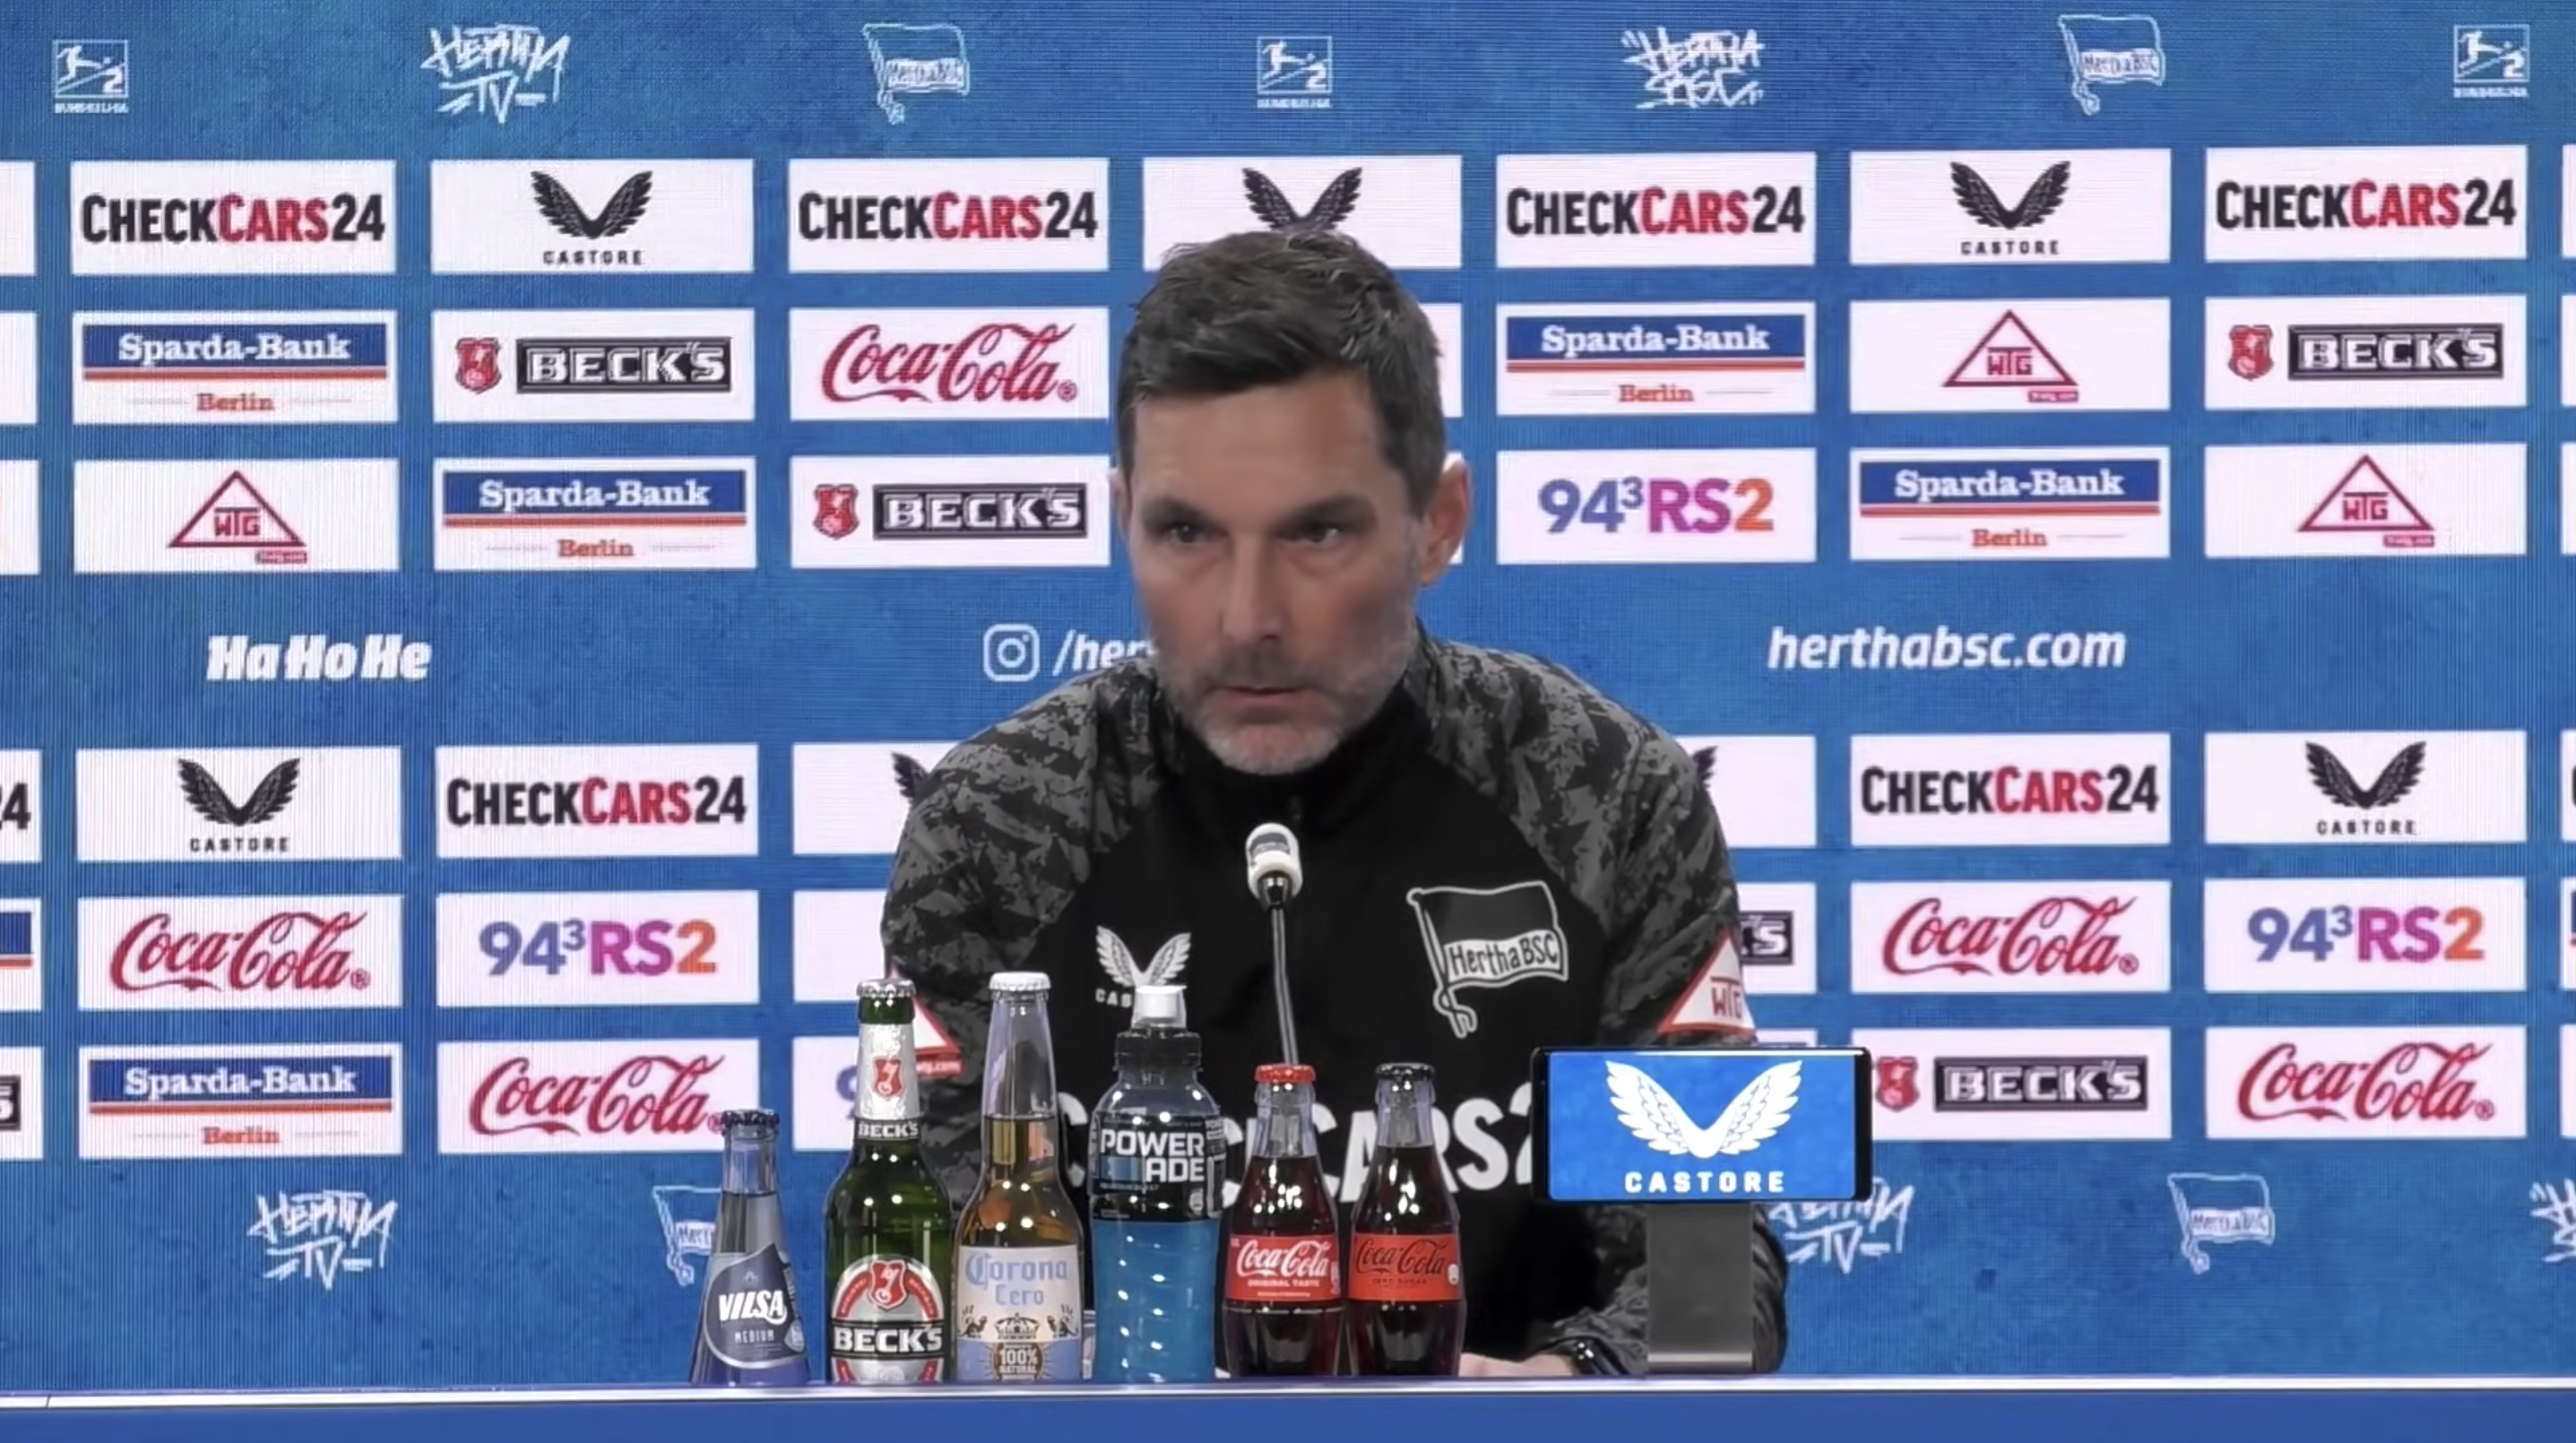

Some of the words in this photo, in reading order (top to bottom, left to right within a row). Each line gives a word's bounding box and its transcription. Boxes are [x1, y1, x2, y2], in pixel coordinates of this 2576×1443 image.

[543, 250, 642, 265] CASTORE
[1961, 240, 2059, 255] CASTORE
[119, 333, 351, 362] Sparda-Bank
[1541, 324, 1769, 358] Sparda-Bank
[2298, 328, 2496, 369] BECK'S
[526, 341, 725, 384] BECK'S
[1987, 347, 2032, 376] WTG
[196, 393, 274, 412] Berlin
[1619, 384, 1694, 403] Berlin
[480, 479, 711, 512] Sparda-Bank
[1895, 469, 2124, 503] Sparda-Bank
[883, 488, 1080, 529] BECK'S
[2343, 491, 2389, 521] WTG
[214, 507, 260, 537] WTG
[558, 540, 635, 558] Berlin
[1972, 528, 2048, 549] Berlin
[1767, 625, 2127, 670] herthabsc.com
[2317, 820, 2415, 835] CASTORE
[190, 837, 289, 852] CASTORE
[125, 1065, 357, 1099] Sparda-Bank
[1943, 1060, 2142, 1102] BECK'S
[203, 1127, 281, 1145] Berlin
[858, 1119, 919, 1138] BECK'S
[1100, 1128, 1205, 1157] POWER
[1145, 1157, 1206, 1183] ADE
[1625, 1171, 1784, 1194] CASTORE
[1237, 1240, 1332, 1277] Coca-Cola
[1356, 1238, 1449, 1275] Coca-Cola
[965, 1252, 1069, 1291] Corona
[1247, 1278, 1290, 1288] ORIGINAL
[1292, 1278, 1320, 1288] TASTE
[719, 1289, 788, 1325] VILSA
[995, 1283, 1045, 1306] Cero
[735, 1328, 774, 1344] MEDIUM
[834, 1324, 943, 1353] BECK'S
[999, 1348, 1038, 1365] 100%
